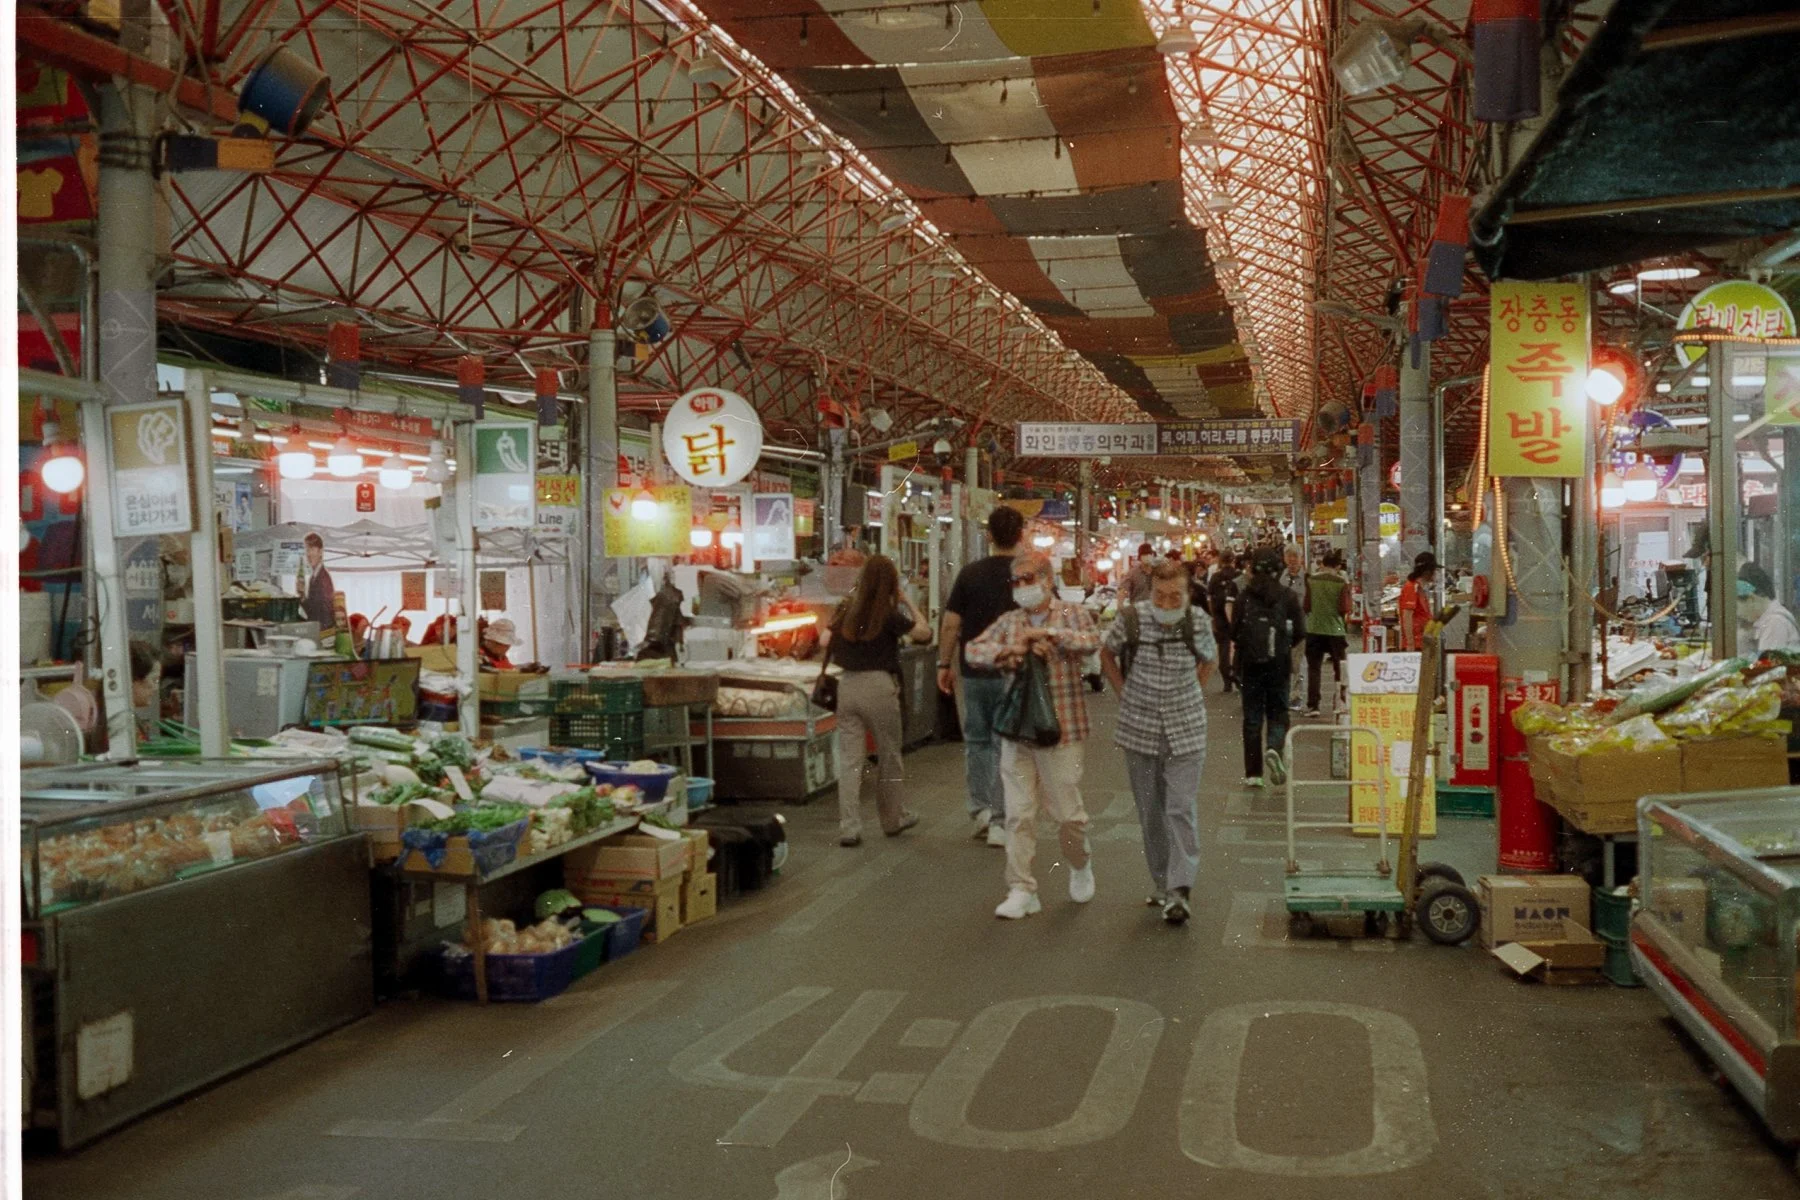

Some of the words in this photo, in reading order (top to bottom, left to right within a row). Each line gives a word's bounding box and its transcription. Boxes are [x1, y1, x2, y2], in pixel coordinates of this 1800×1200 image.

[1498, 294, 1580, 334] 장충동
[1506, 342, 1574, 464] 족발
[681, 424, 735, 477] 닭
[128, 508, 179, 527] 김치가게
